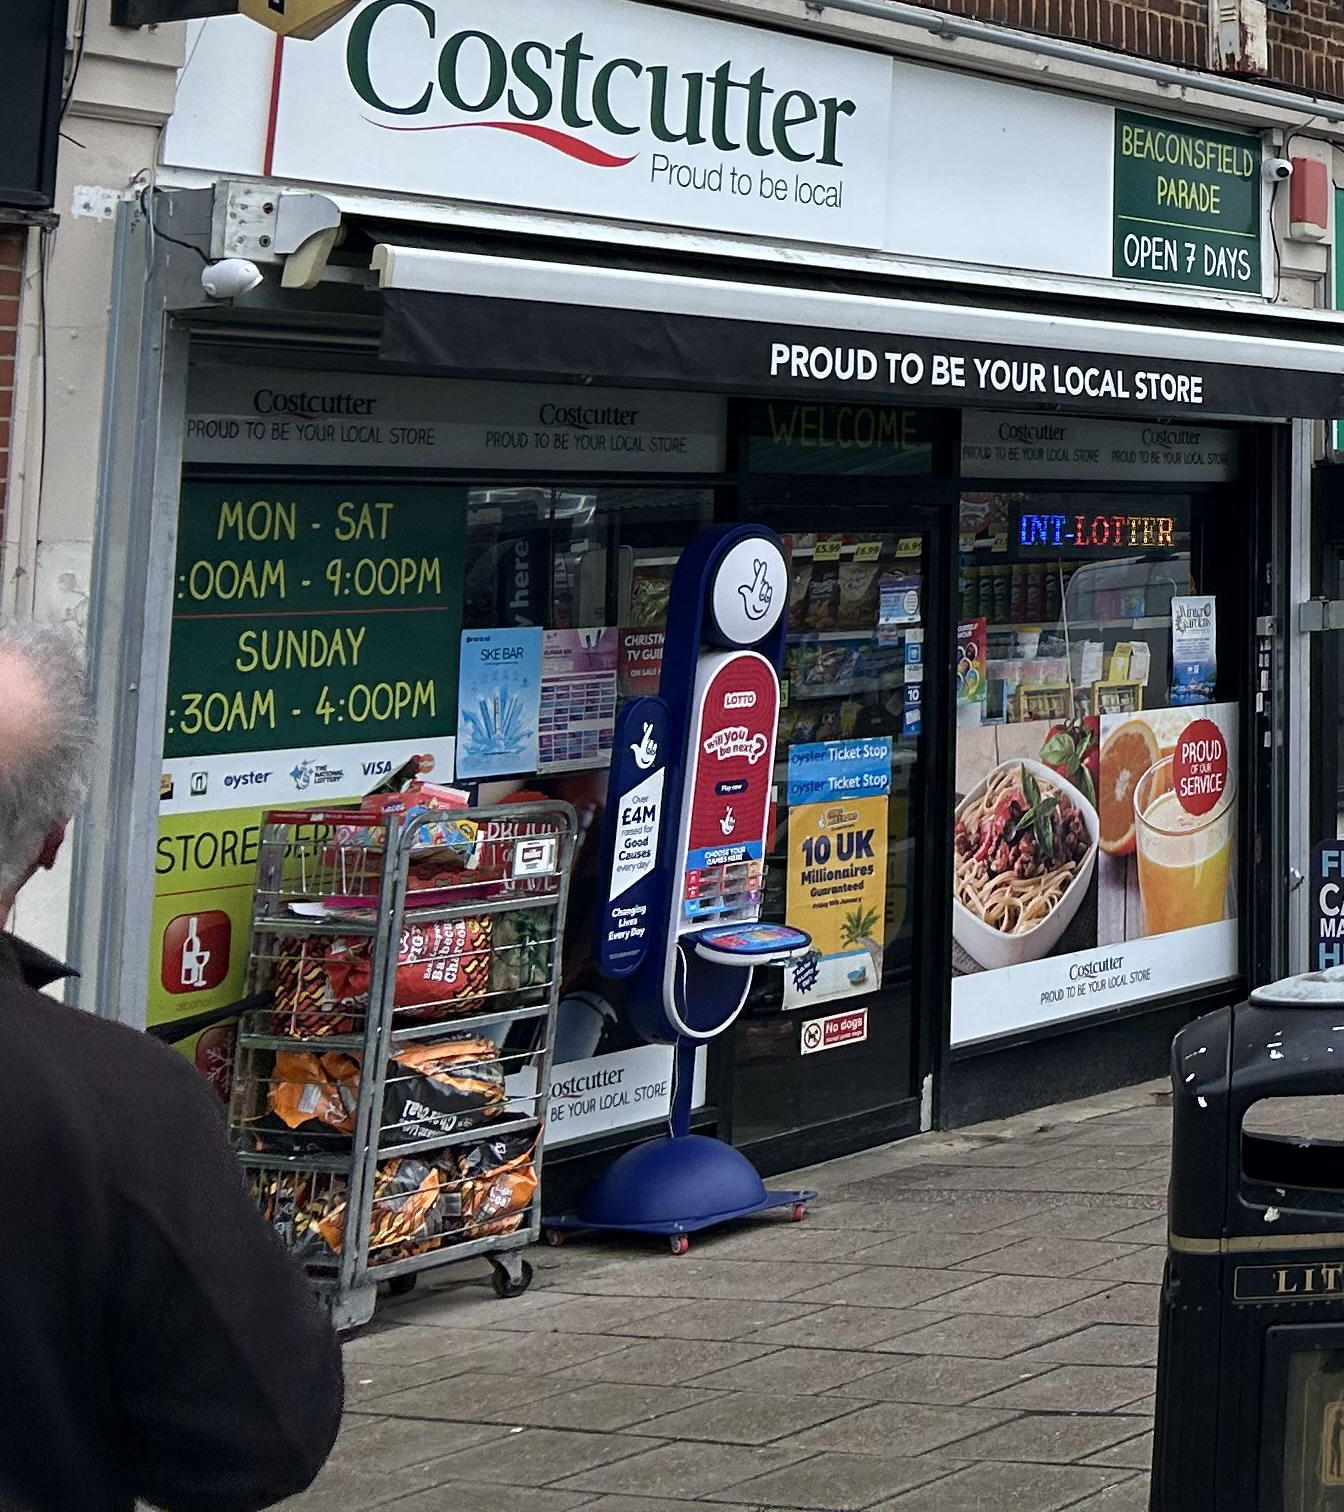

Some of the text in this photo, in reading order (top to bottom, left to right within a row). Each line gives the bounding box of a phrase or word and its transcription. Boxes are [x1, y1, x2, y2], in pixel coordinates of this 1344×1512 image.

[1122, 125, 1253, 177] BEACONSFIELD
[651, 154, 842, 208] Proud to be local
[1157, 176, 1220, 214] PARADE
[1124, 234, 1251, 281] OPEN 7 DAYS
[770, 343, 1203, 404] PROUD TO BE YOUR LOCAL STORE
[254, 389, 377, 415] Costcutter
[539, 403, 640, 426] Costcutter
[768, 402, 918, 450] WELCOME
[187, 420, 436, 446] PROUD TO BE YOUR LOCAL STORE
[486, 431, 688, 454] PROUD TO BE YOUR LOCAL STORE
[999, 422, 1067, 441] Costcutter
[1142, 428, 1201, 445] Costcutter
[962, 446, 1099, 463] PROUD TO BE YOUR LOCAL STORE
[217, 501, 297, 542] MON
[335, 502, 395, 542] SAT
[177, 559, 287, 601] :00AM
[325, 558, 442, 597] 9:00PM
[510, 540, 530, 608] here
[235, 626, 367, 674] SUNDAY
[480, 646, 524, 661] SKE BAR
[627, 649, 640, 662] TV
[167, 688, 276, 735] :30AM
[315, 679, 436, 726] 4:00PM
[726, 694, 754, 705] LOTTO
[907, 689, 920, 702] 10
[724, 730, 746, 745] you
[828, 744, 888, 761] Ticket Stop
[1182, 739, 1222, 764] PROUD
[361, 760, 392, 775] VISA
[224, 771, 271, 789] oyster
[828, 774, 888, 791] Ticket Stop
[1180, 773, 1222, 796] SERVICE
[632, 795, 649, 805] Over
[622, 804, 656, 825] £4M
[155, 826, 259, 875] STORE
[624, 836, 649, 849] Good
[802, 829, 875, 867] 10 UK
[619, 849, 651, 861] Causes
[801, 864, 874, 885] Millionaires
[810, 880, 864, 898] Guaranteed
[612, 904, 646, 918] Changing
[618, 917, 638, 928] Lives
[608, 927, 645, 941] Every Day
[1069, 957, 1124, 980] Costcutter
[1041, 968, 1151, 1004] PROUD TO BE YOUR LOCAL STORE
[825, 1018, 862, 1034] No dogs
[550, 1068, 624, 1098] ostcutter
[551, 1080, 667, 1122] BE YOUR LOCAL STORE
